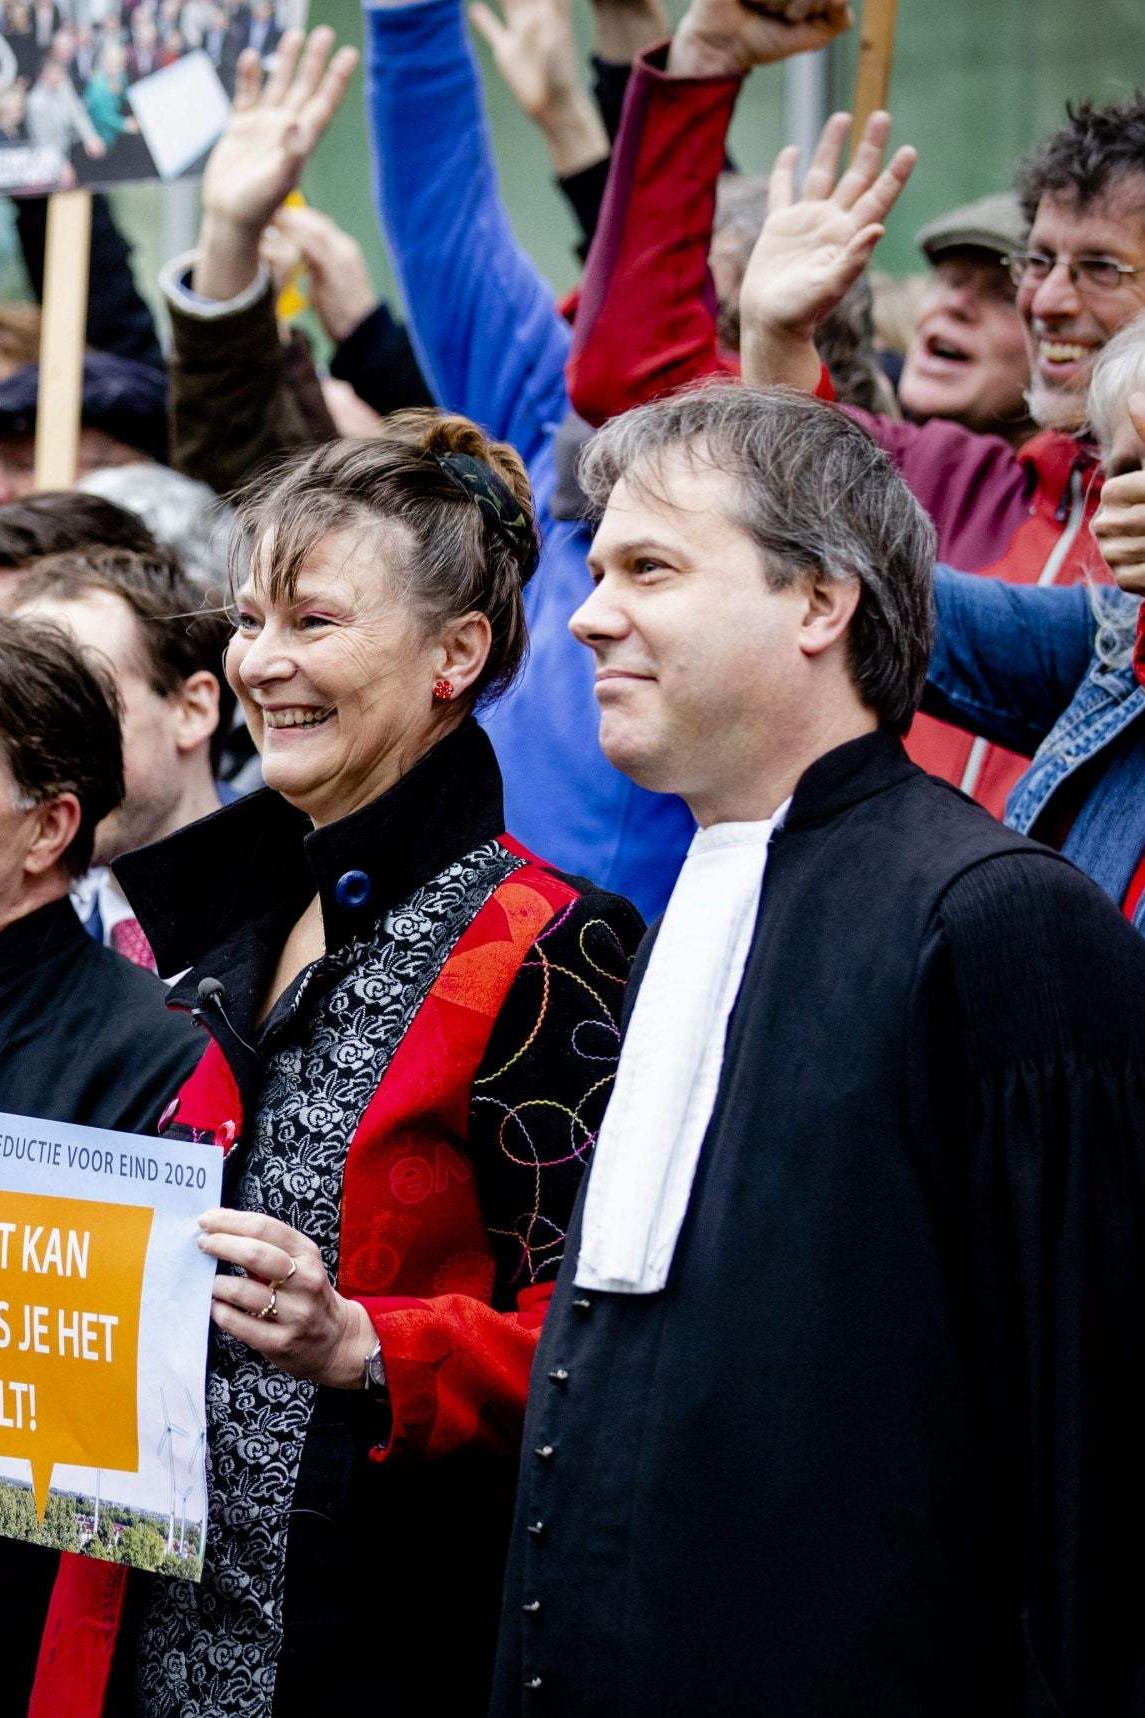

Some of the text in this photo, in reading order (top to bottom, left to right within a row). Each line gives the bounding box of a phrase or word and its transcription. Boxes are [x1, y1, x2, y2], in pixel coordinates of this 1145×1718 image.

[67, 1144, 114, 1175] VOOR
[119, 1153, 159, 1182] EIND
[164, 1161, 207, 1190] 2020
[22, 1224, 91, 1279] KAN
[18, 1304, 50, 1354] JE
[58, 1309, 119, 1363] HET
